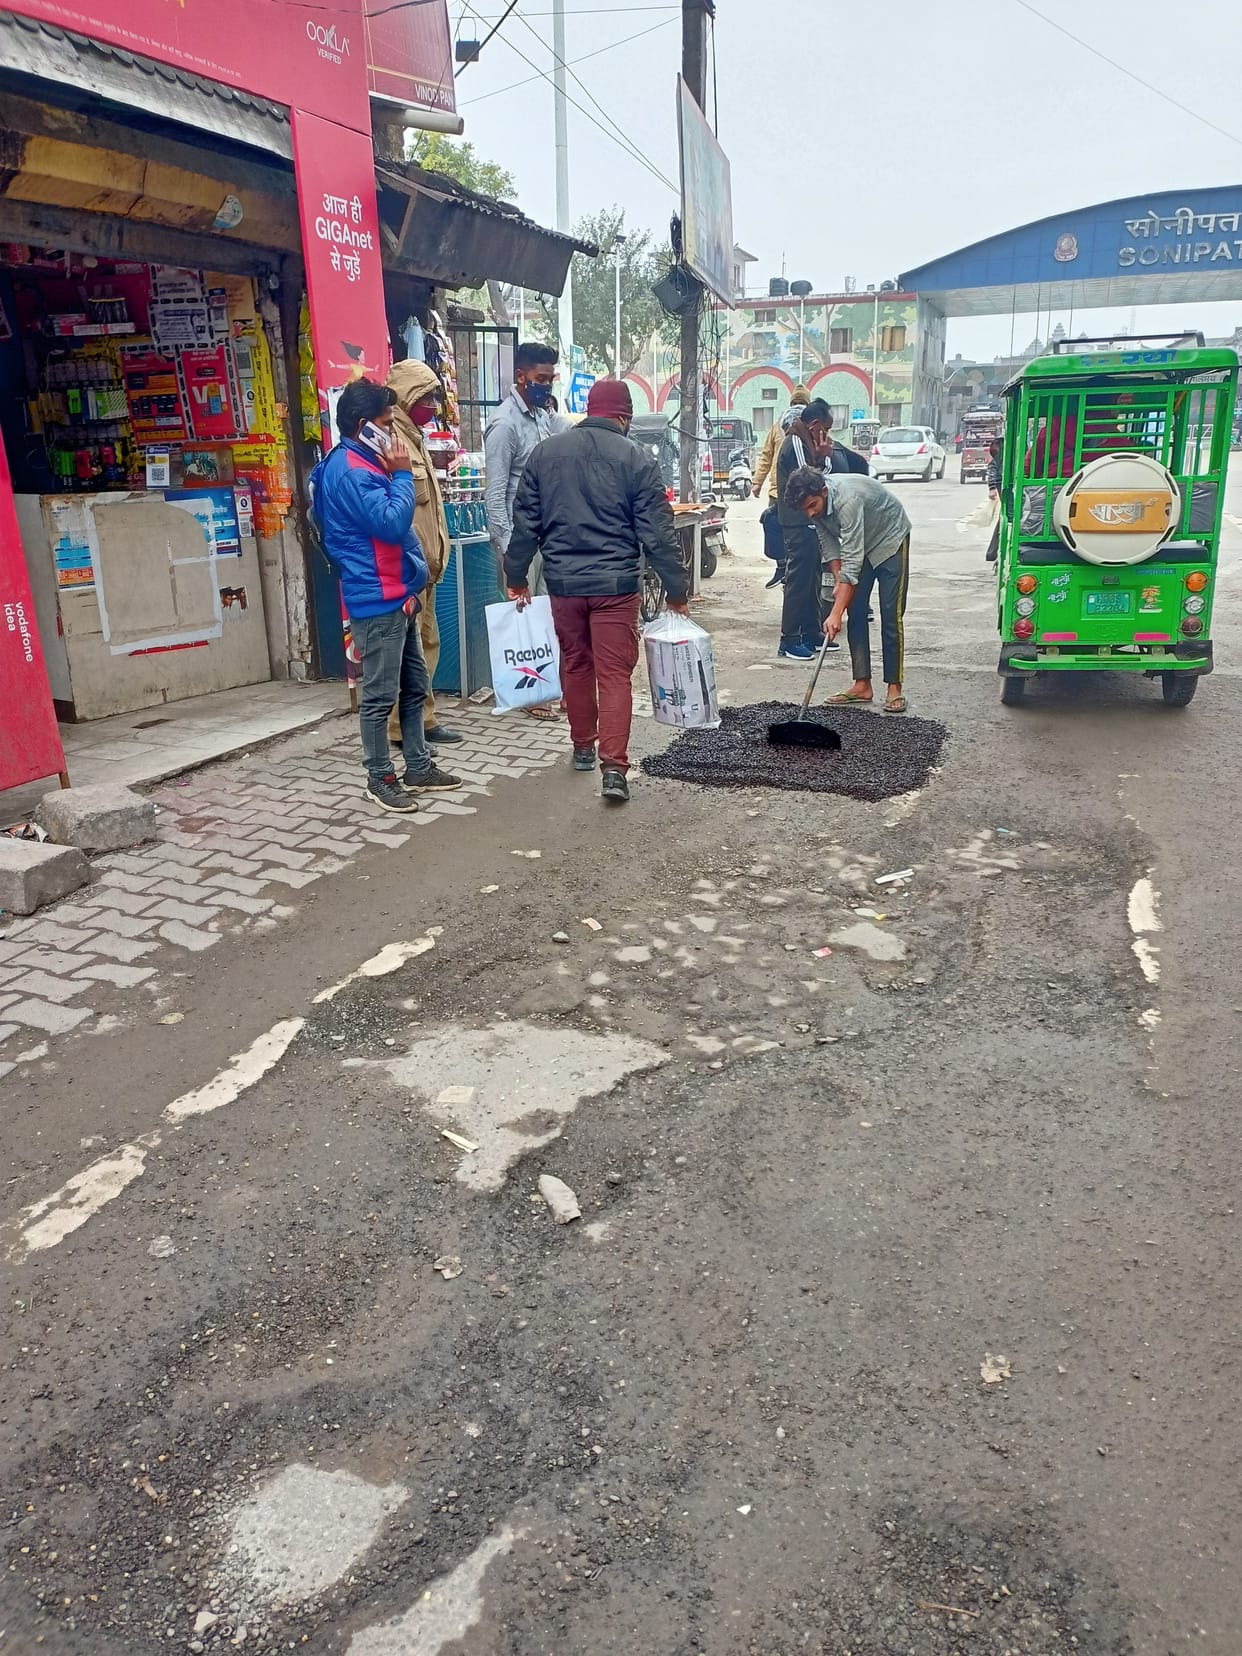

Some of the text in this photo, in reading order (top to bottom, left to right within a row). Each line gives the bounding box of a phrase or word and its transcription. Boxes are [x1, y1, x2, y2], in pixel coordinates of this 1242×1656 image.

[306, 21, 350, 57] OOKLA
[317, 47, 342, 65] VERIFIED
[415, 83, 439, 103] VINOD
[322, 193, 362, 223] आज ही
[1124, 207, 1242, 238] सोनीपत
[315, 216, 373, 250] GIGAnet
[330, 245, 361, 282] से जुड़ें
[1118, 240, 1242, 267] SONIPAT
[4, 603, 16, 632] idea
[15, 602, 34, 662] vodafone
